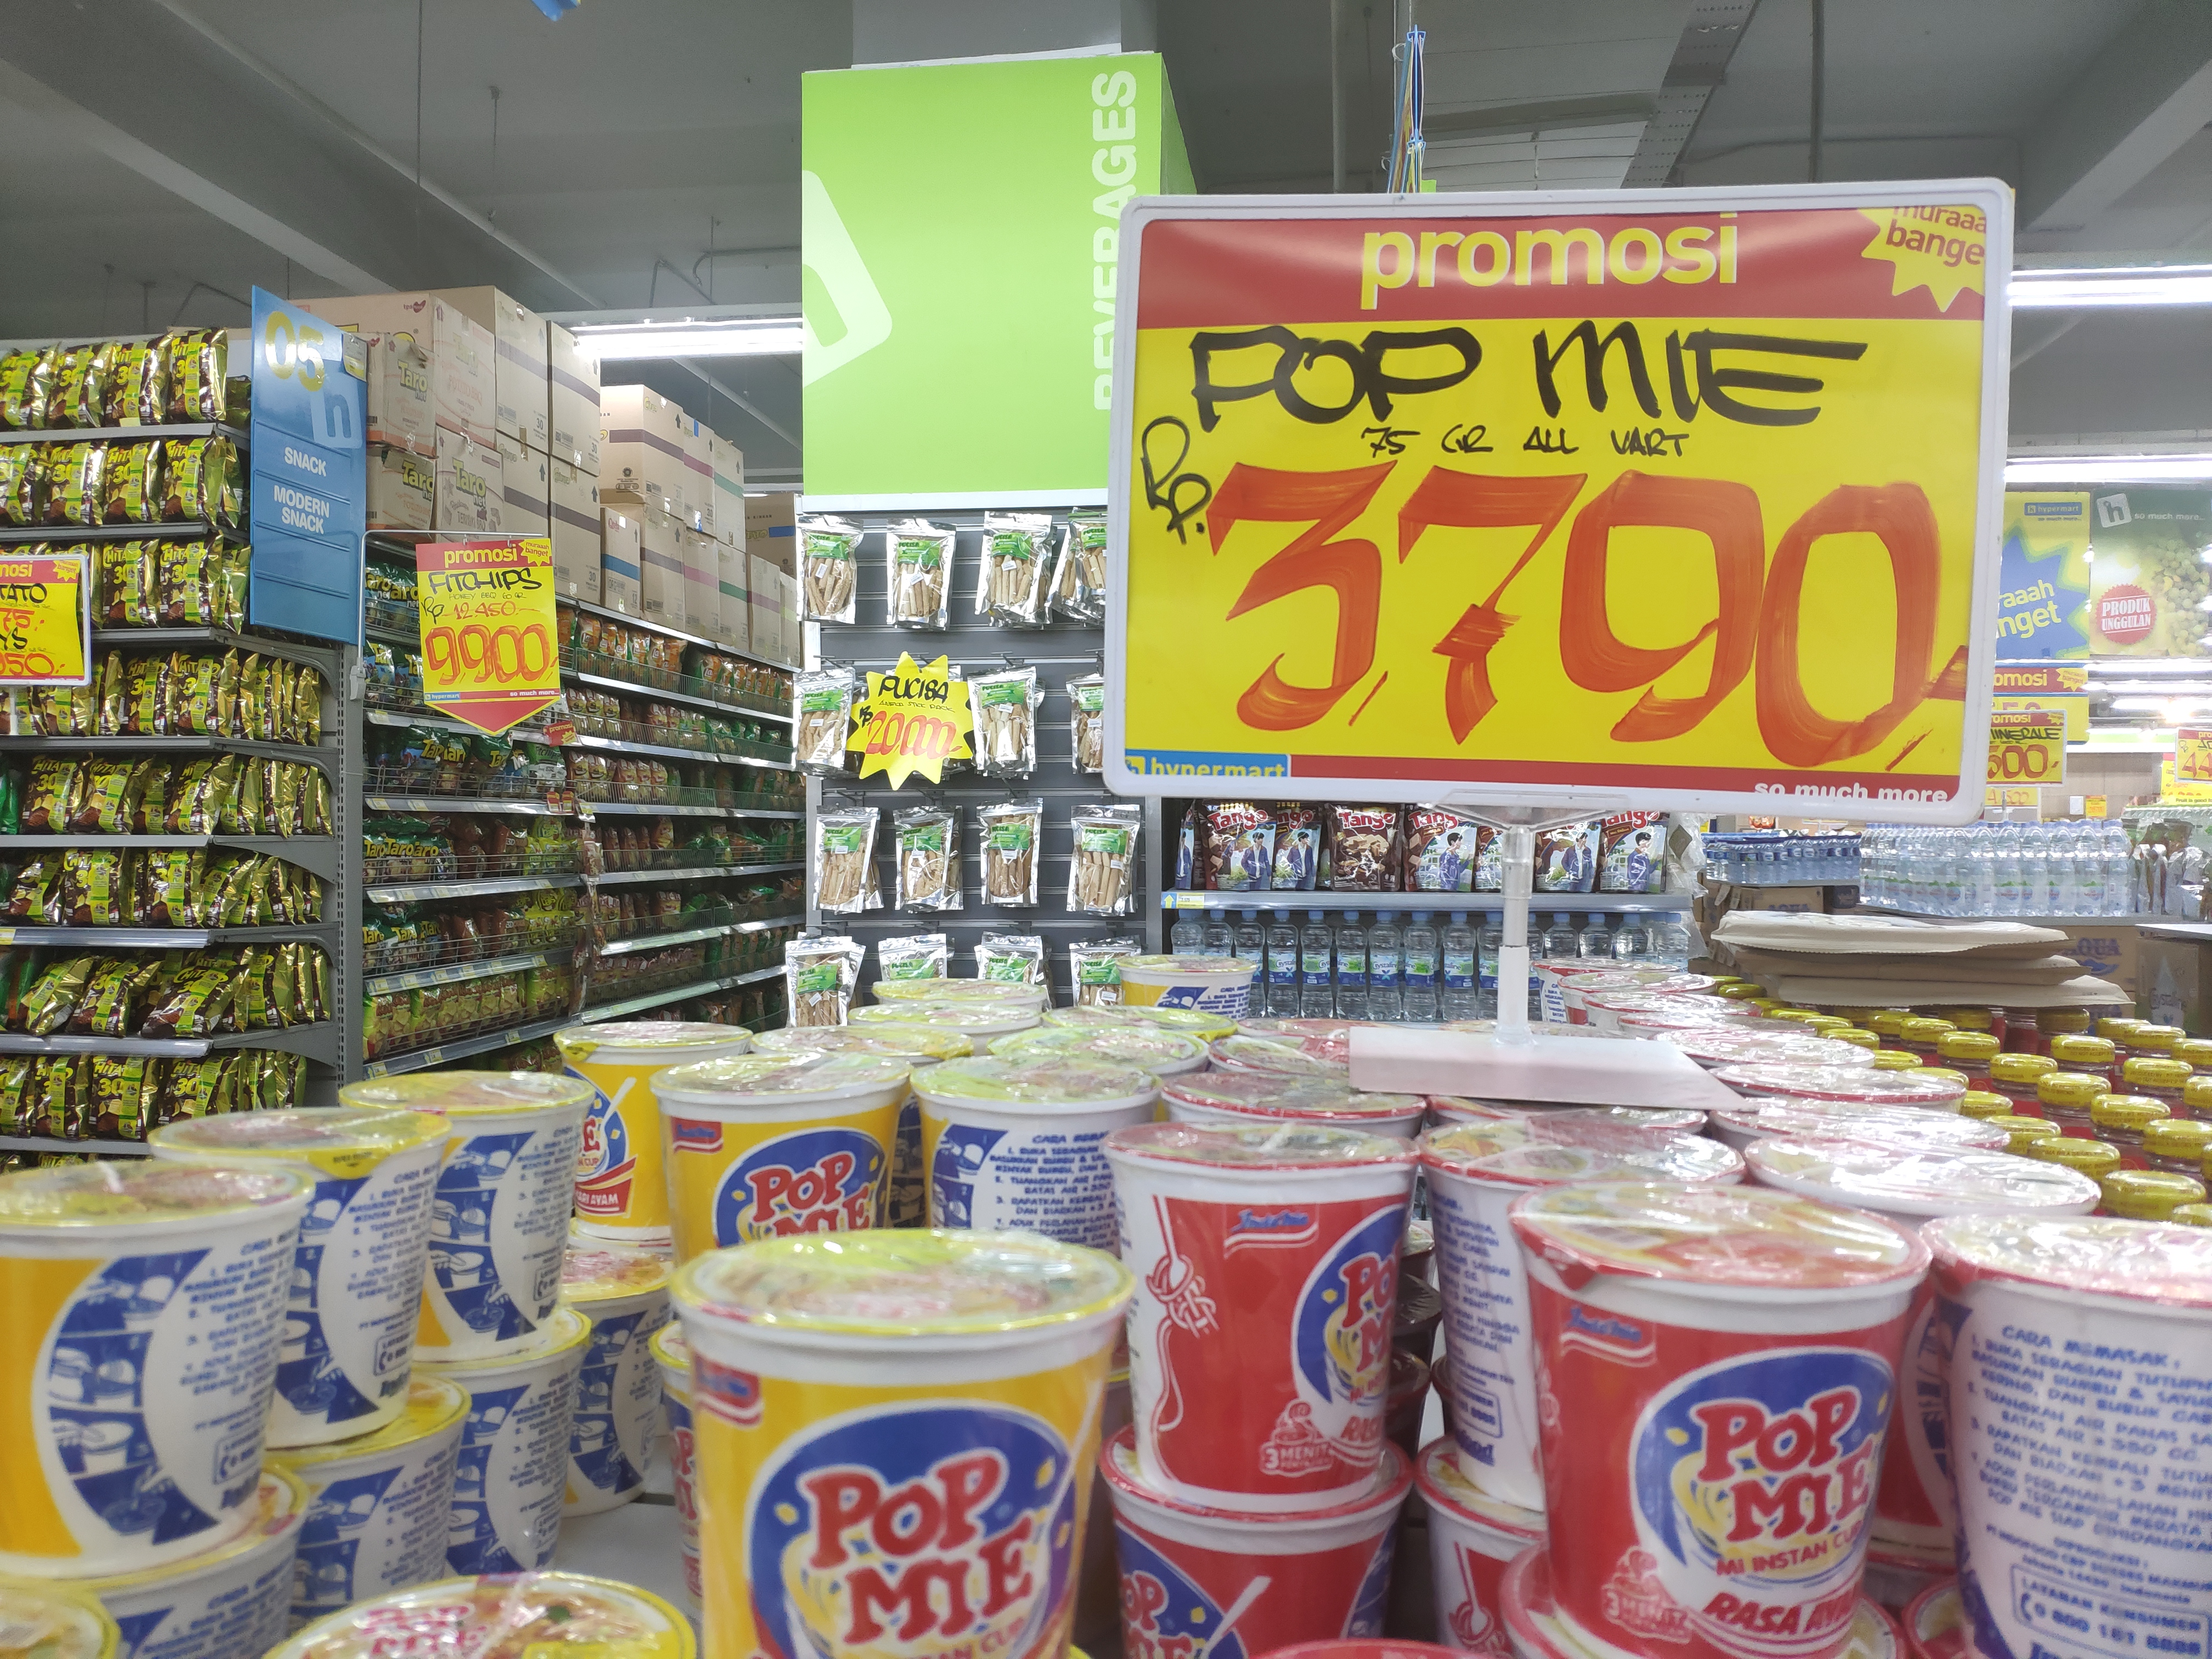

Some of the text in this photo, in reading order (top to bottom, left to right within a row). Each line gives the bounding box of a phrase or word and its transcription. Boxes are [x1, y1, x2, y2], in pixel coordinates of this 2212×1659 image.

[1893, 206, 1986, 235] muraaa
[1885, 221, 1985, 268] bange
[1361, 212, 1738, 311] promosi
[266, 311, 325, 392] 05
[397, 359, 427, 392] Taro
[1189, 319, 1869, 434] POP MIE
[1361, 426, 1421, 459] 75
[1522, 426, 1580, 456] ALL
[284, 446, 326, 477] SNACK
[452, 456, 487, 497] Taro
[274, 485, 330, 518] MODERN
[422, 489, 432, 501] ne
[2038, 505, 2079, 513] hypermart
[281, 506, 325, 535] SNACK
[444, 544, 517, 568] promosi
[525, 546, 549, 558] banget
[390, 585, 419, 600] aro
[428, 568, 543, 595] FITCHIPS
[1999, 579, 2055, 608] aaah
[449, 592, 476, 601] HONEY
[2102, 597, 2151, 617] PRODUK
[1997, 600, 2062, 639] nget
[2101, 614, 2151, 631] UNGGULAN
[877, 675, 949, 704] PUCISA
[1994, 669, 2047, 686] omosi
[549, 723, 573, 733] promosi
[1991, 714, 2031, 724] omosi
[1755, 782, 1948, 804] so much more
[1207, 809, 1269, 831] Tango
[1277, 809, 1314, 831] ngo
[1338, 811, 1395, 830] Tango
[1408, 810, 1460, 830] Tang
[1603, 810, 1661, 829] ango
[385, 838, 413, 856] Taro
[413, 841, 439, 857] aro
[749, 1153, 853, 1222] POP
[1343, 1245, 1400, 1328] PO
[2002, 1325, 2052, 1348] CARA
[1695, 1389, 1858, 1483] POP
[1726, 1437, 1872, 1543] MIE
[803, 1454, 1002, 1569] POP
[1752, 1541, 1827, 1572] INSTAN
[843, 1514, 1034, 1645] MIE
